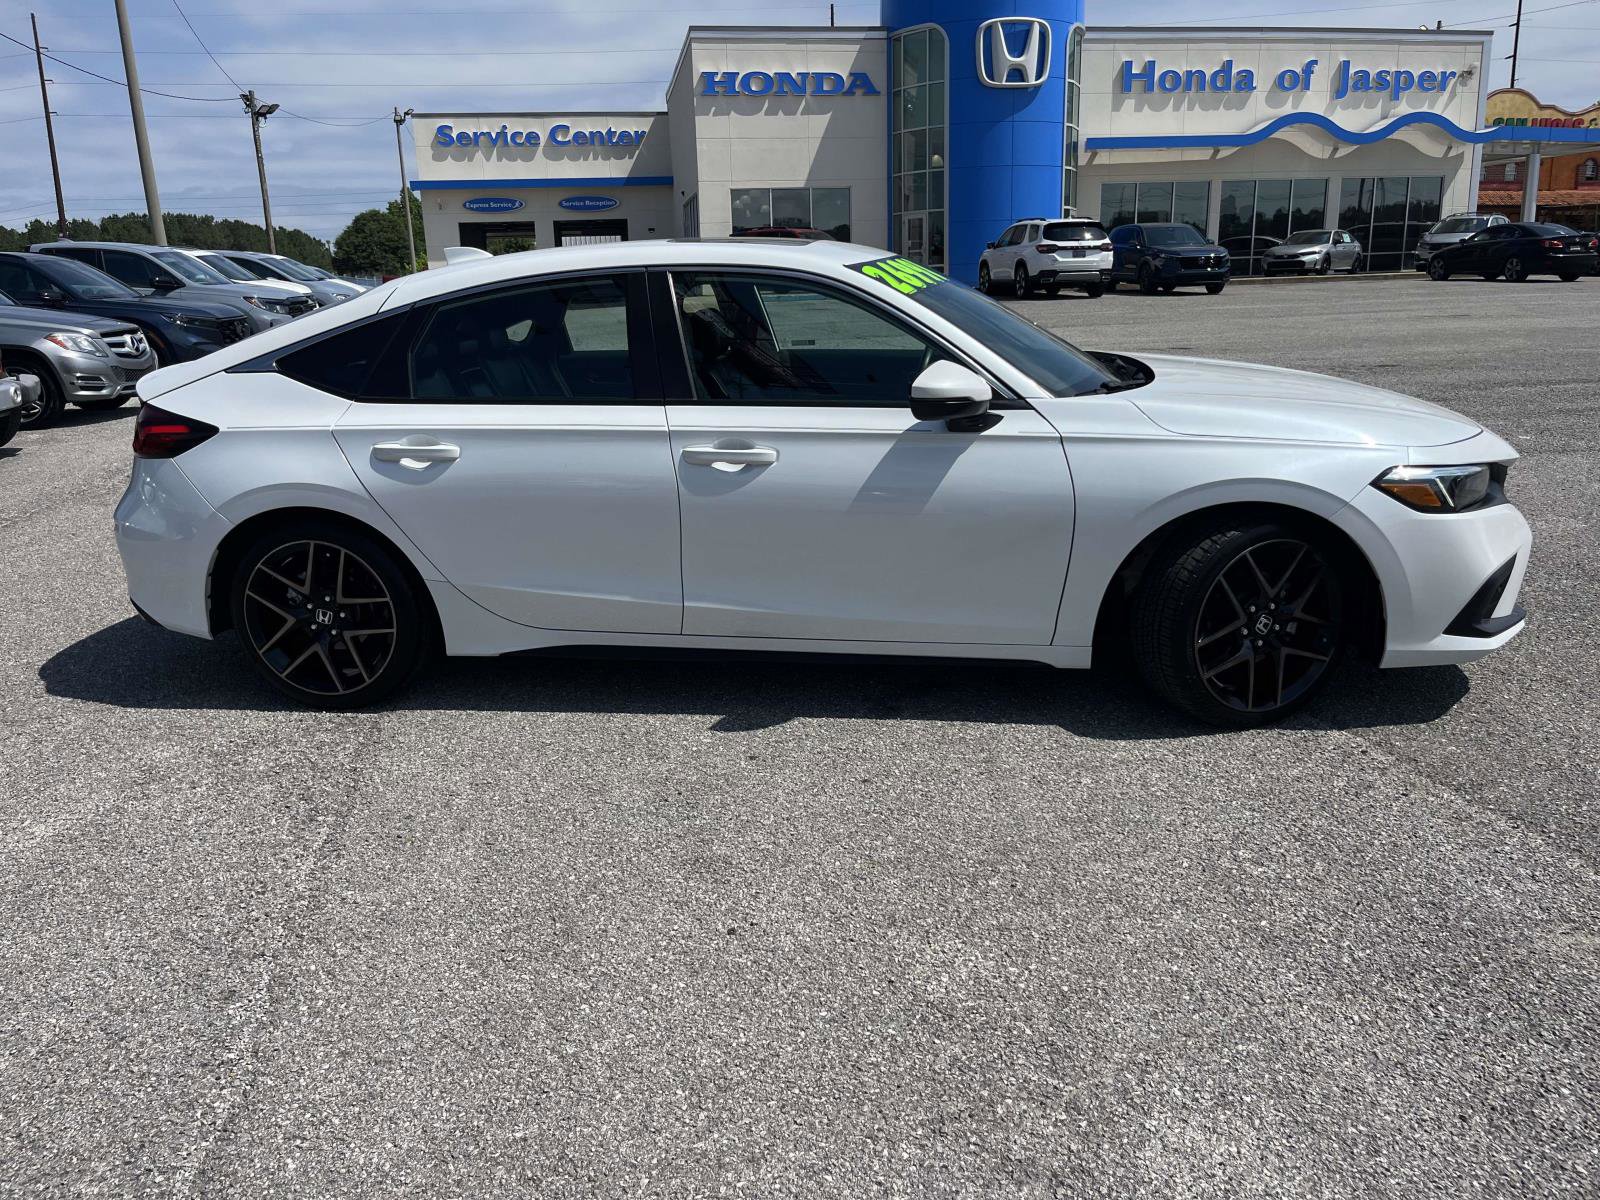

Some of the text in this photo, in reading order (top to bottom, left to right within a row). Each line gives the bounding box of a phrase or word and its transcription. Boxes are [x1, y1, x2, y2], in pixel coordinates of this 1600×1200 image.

[700, 71, 881, 96] HONDA
[1122, 59, 1457, 101] Honda of Jasper
[436, 124, 647, 147] Service Center
